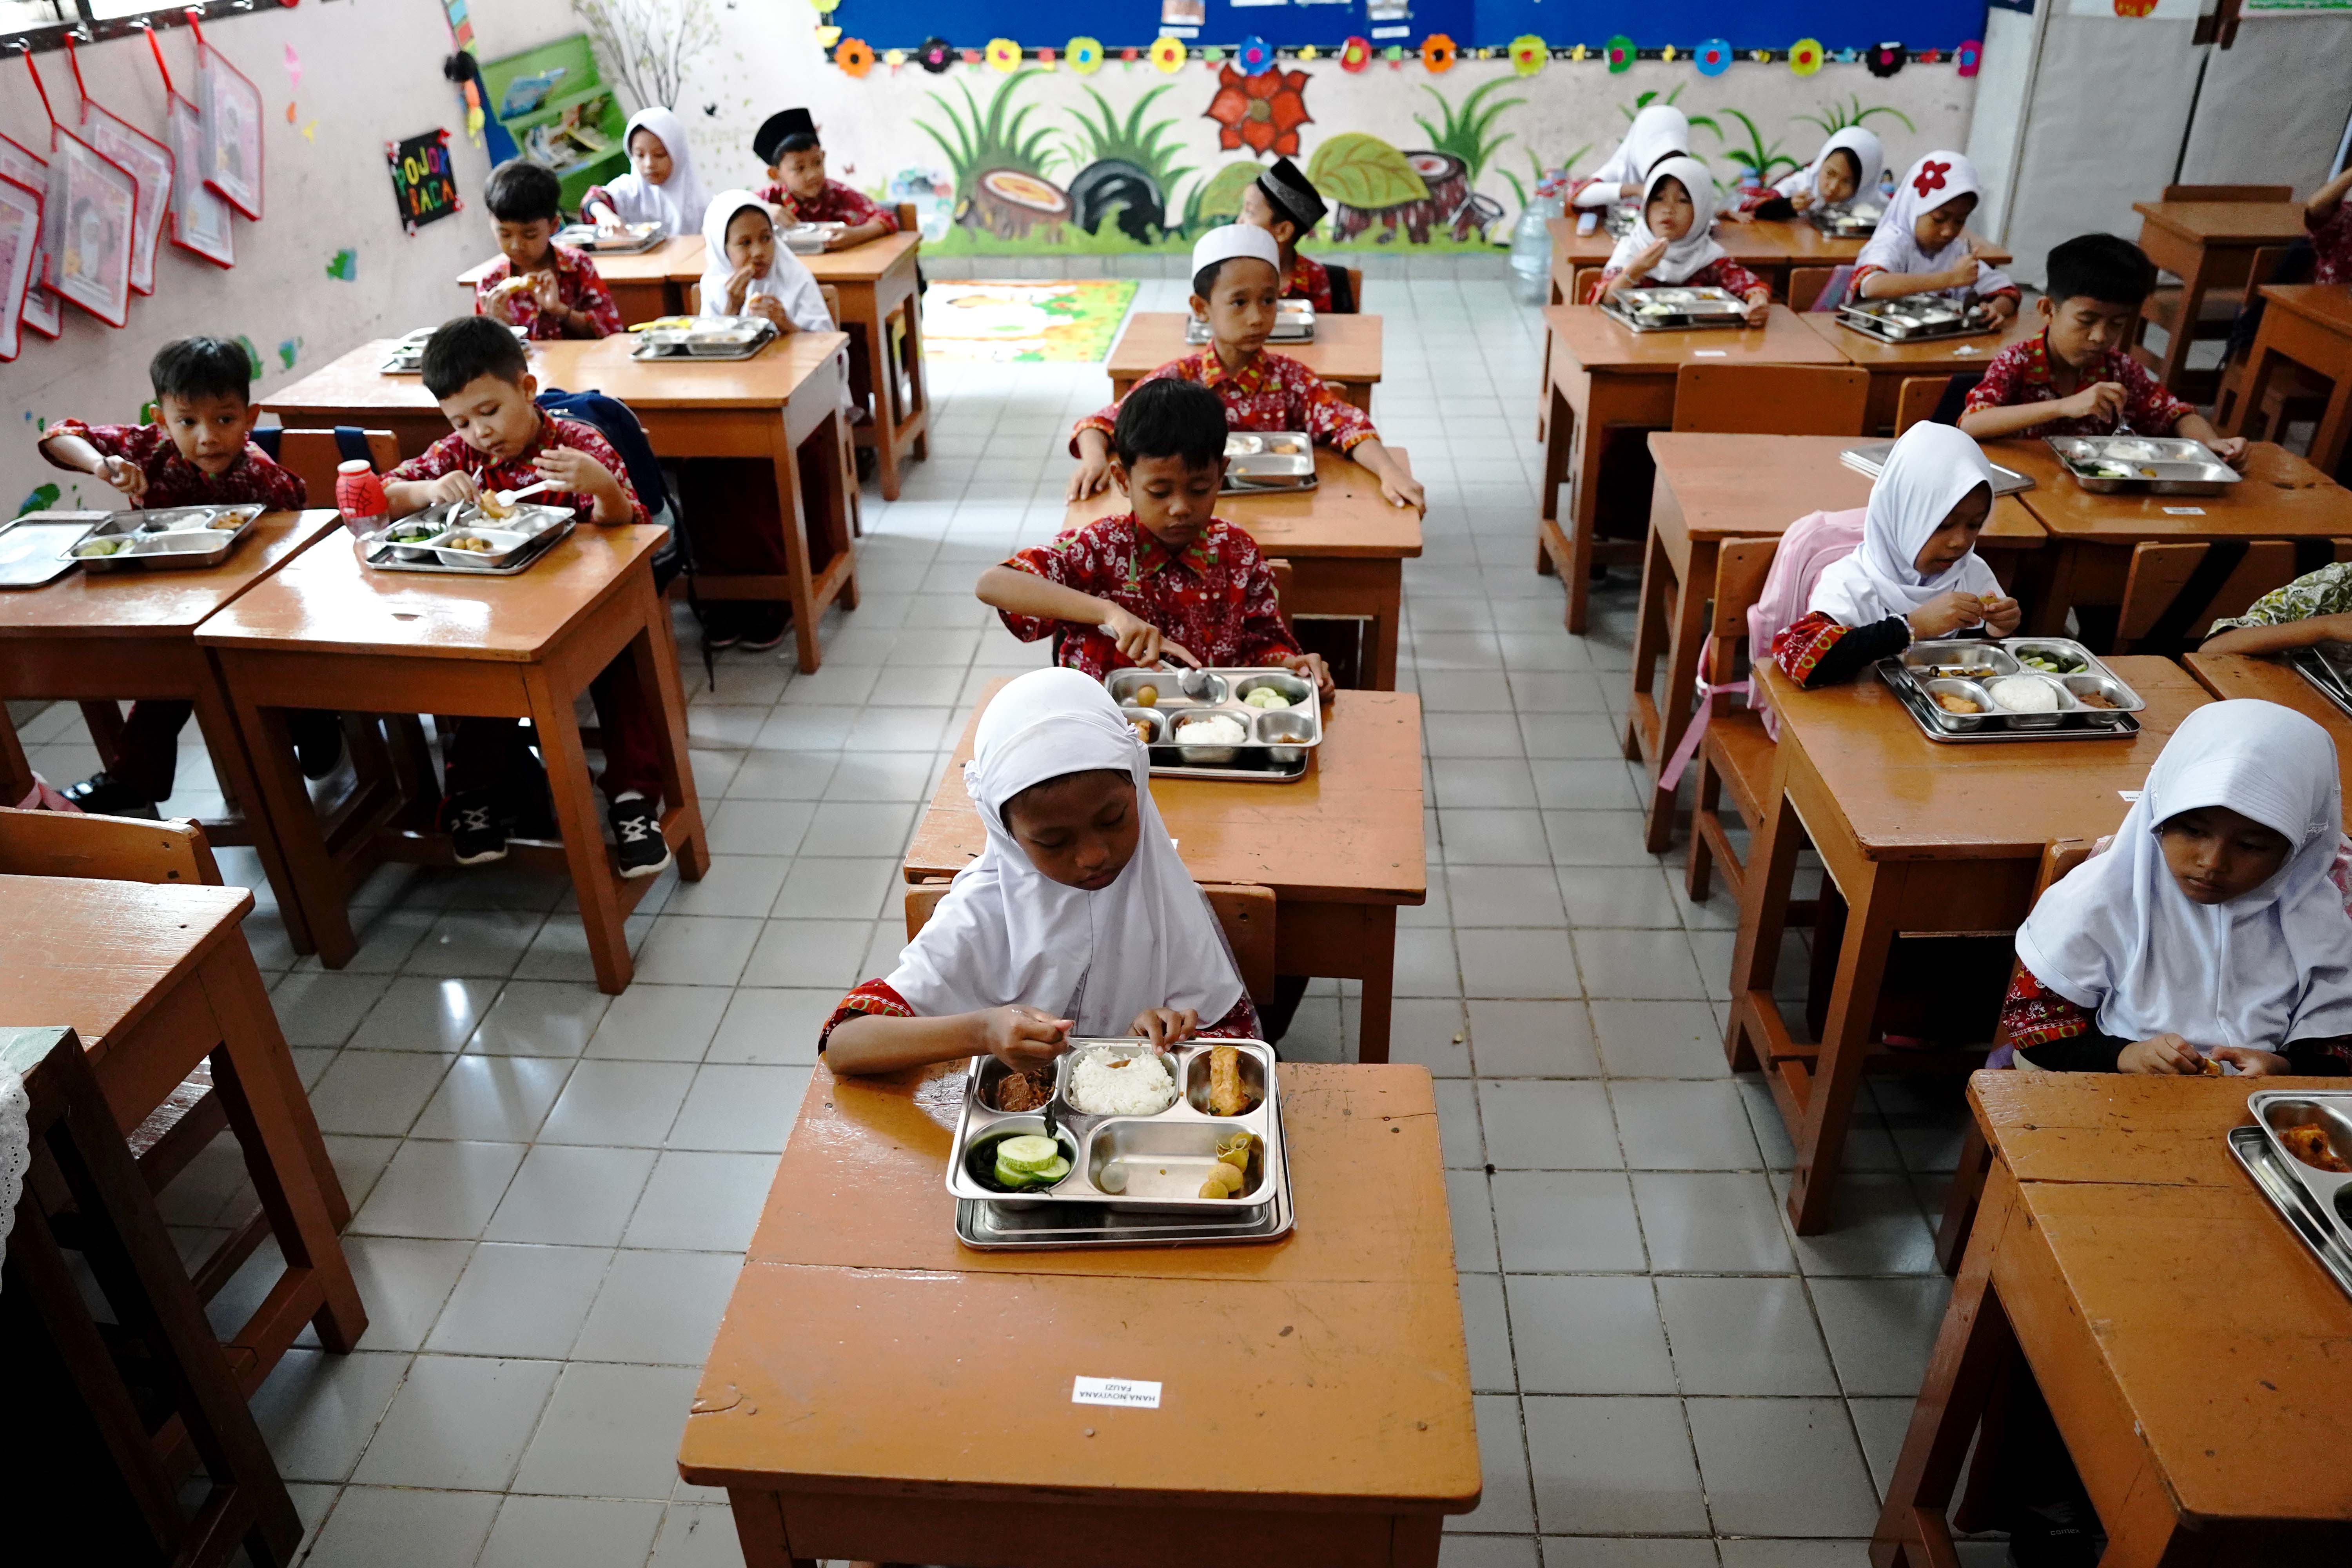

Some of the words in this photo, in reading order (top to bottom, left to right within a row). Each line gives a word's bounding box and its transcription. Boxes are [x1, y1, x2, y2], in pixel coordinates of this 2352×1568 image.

[396, 146, 450, 196] POJOK
[408, 179, 455, 216] BACA
[1080, 1391, 1126, 1399] NOVIYANA
